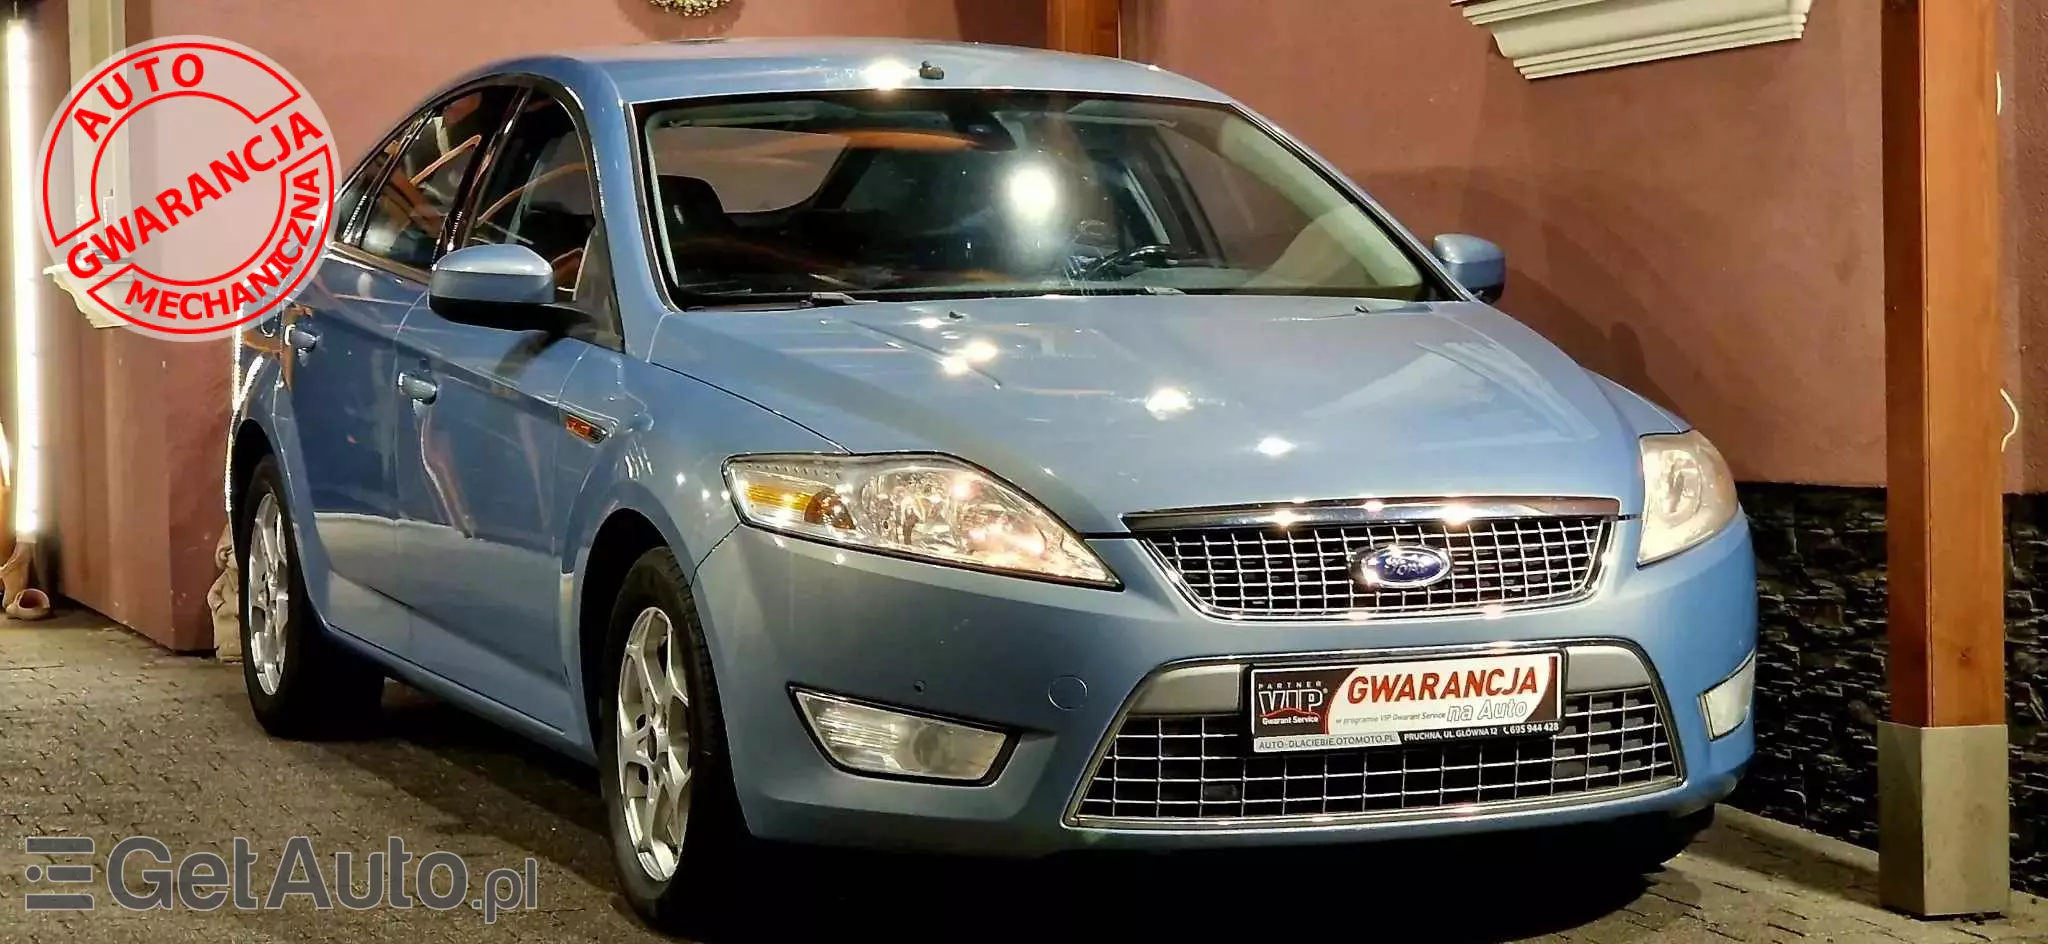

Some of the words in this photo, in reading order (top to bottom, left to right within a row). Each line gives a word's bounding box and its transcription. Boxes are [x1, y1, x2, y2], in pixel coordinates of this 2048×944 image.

[1258, 680, 1322, 690] PARTNER
[1347, 666, 1538, 705] GWARANCJA
[1258, 688, 1323, 716] VIP
[1447, 704, 1474, 722] na
[1476, 699, 1528, 720] Auto
[1262, 716, 1291, 725] Gwarant
[1292, 715, 1319, 724] Service
[1422, 711, 1446, 720] Service
[1443, 730, 1455, 738] UL.
[1456, 727, 1489, 739] GŁÓWNA
[1489, 727, 1498, 736] 12
[1510, 724, 1526, 734] 695
[1526, 723, 1542, 733] 944
[1543, 722, 1559, 731] 428
